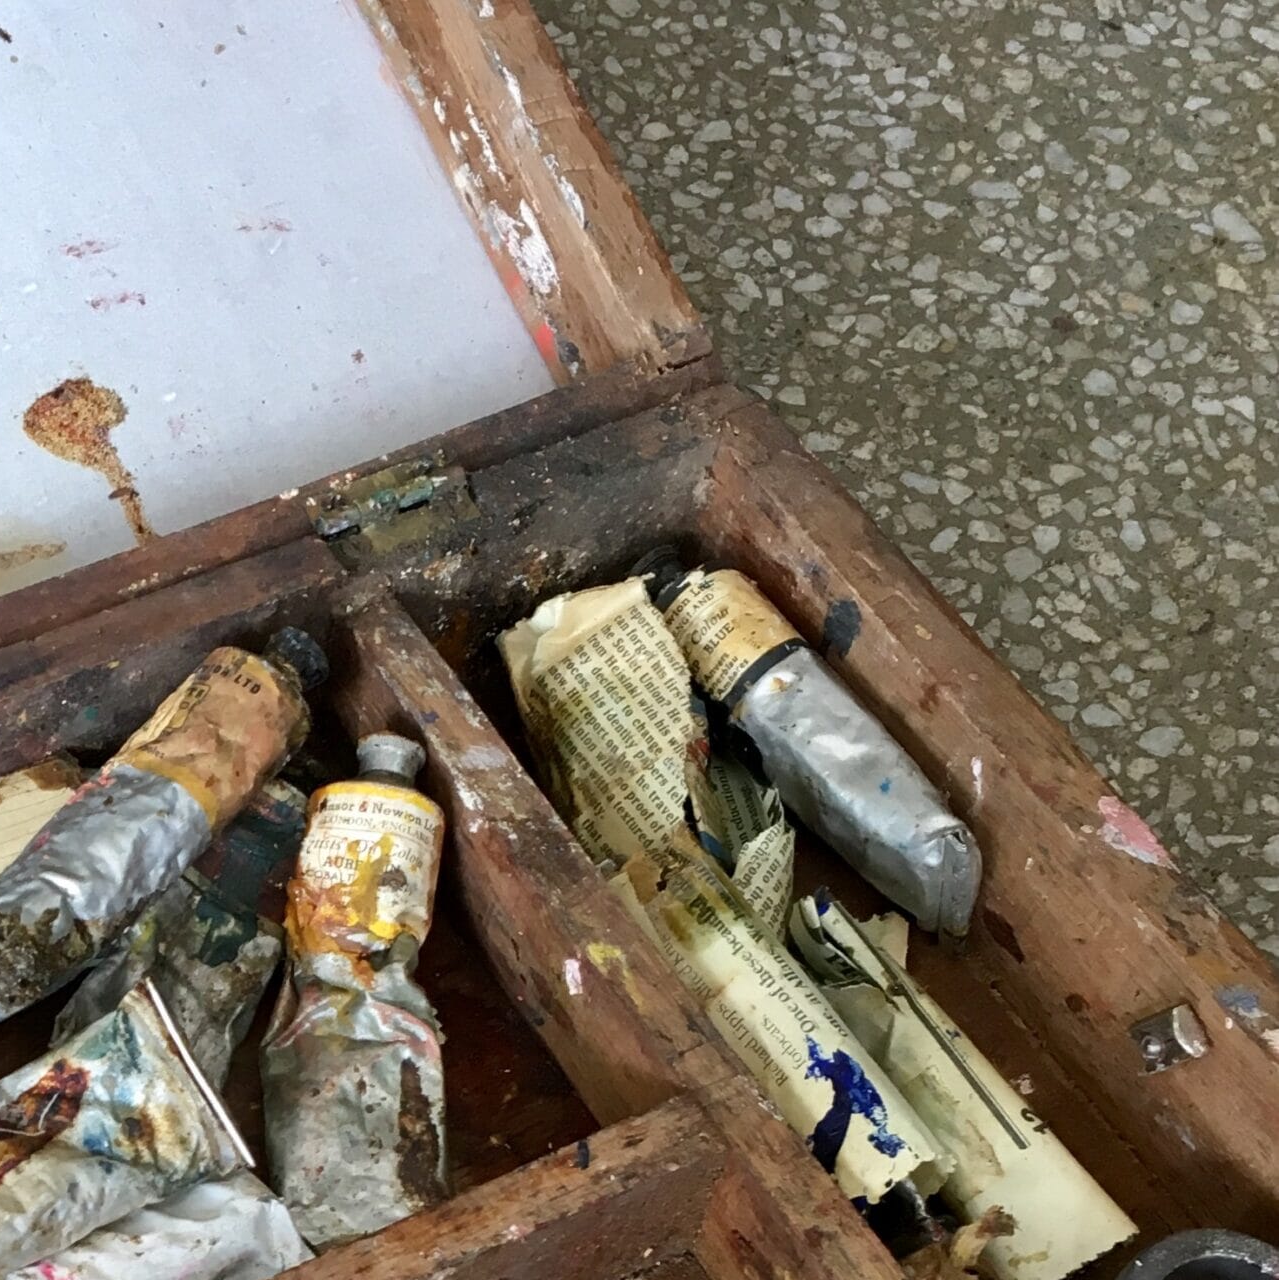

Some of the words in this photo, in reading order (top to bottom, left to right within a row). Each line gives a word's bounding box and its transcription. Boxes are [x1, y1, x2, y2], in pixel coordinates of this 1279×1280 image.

[662, 596, 692, 626] wton
[686, 601, 732, 646] Colour
[613, 613, 630, 632] can
[650, 660, 668, 680] his
[701, 620, 736, 655] BLUE
[231, 671, 263, 696] LTD
[586, 633, 608, 657] from
[636, 696, 658, 721] with
[654, 718, 671, 737] his
[600, 623, 616, 640] the
[611, 637, 641, 674] Soviet
[638, 672, 669, 711] Union?
[666, 707, 683, 725] He
[589, 665, 623, 706] decided
[620, 703, 634, 717] to
[631, 715, 665, 757] change
[565, 687, 585, 708] His
[577, 704, 610, 742] report
[604, 737, 621, 755] on
[616, 750, 639, 778] how
[635, 774, 652, 793] he
[589, 689, 607, 709] his
[602, 706, 639, 751] identity
[634, 747, 669, 789] papers
[567, 716, 598, 754] Union
[594, 749, 618, 777] with
[623, 788, 654, 823] proof
[648, 818, 664, 833] of
[371, 802, 423, 824] Newton
[587, 767, 612, 795] with
[612, 797, 655, 850] textured
[712, 764, 745, 832] educational
[580, 817, 603, 843] that
[761, 857, 782, 885] into
[757, 895, 774, 918] the
[740, 918, 764, 944] We
[678, 961, 717, 1004] Alfred
[739, 949, 777, 991] these
[769, 985, 791, 1007] of
[801, 987, 818, 1005] at
[782, 1000, 817, 1037] One
[742, 1035, 790, 1088] Richard
[754, 1010, 808, 1071] forbears.
